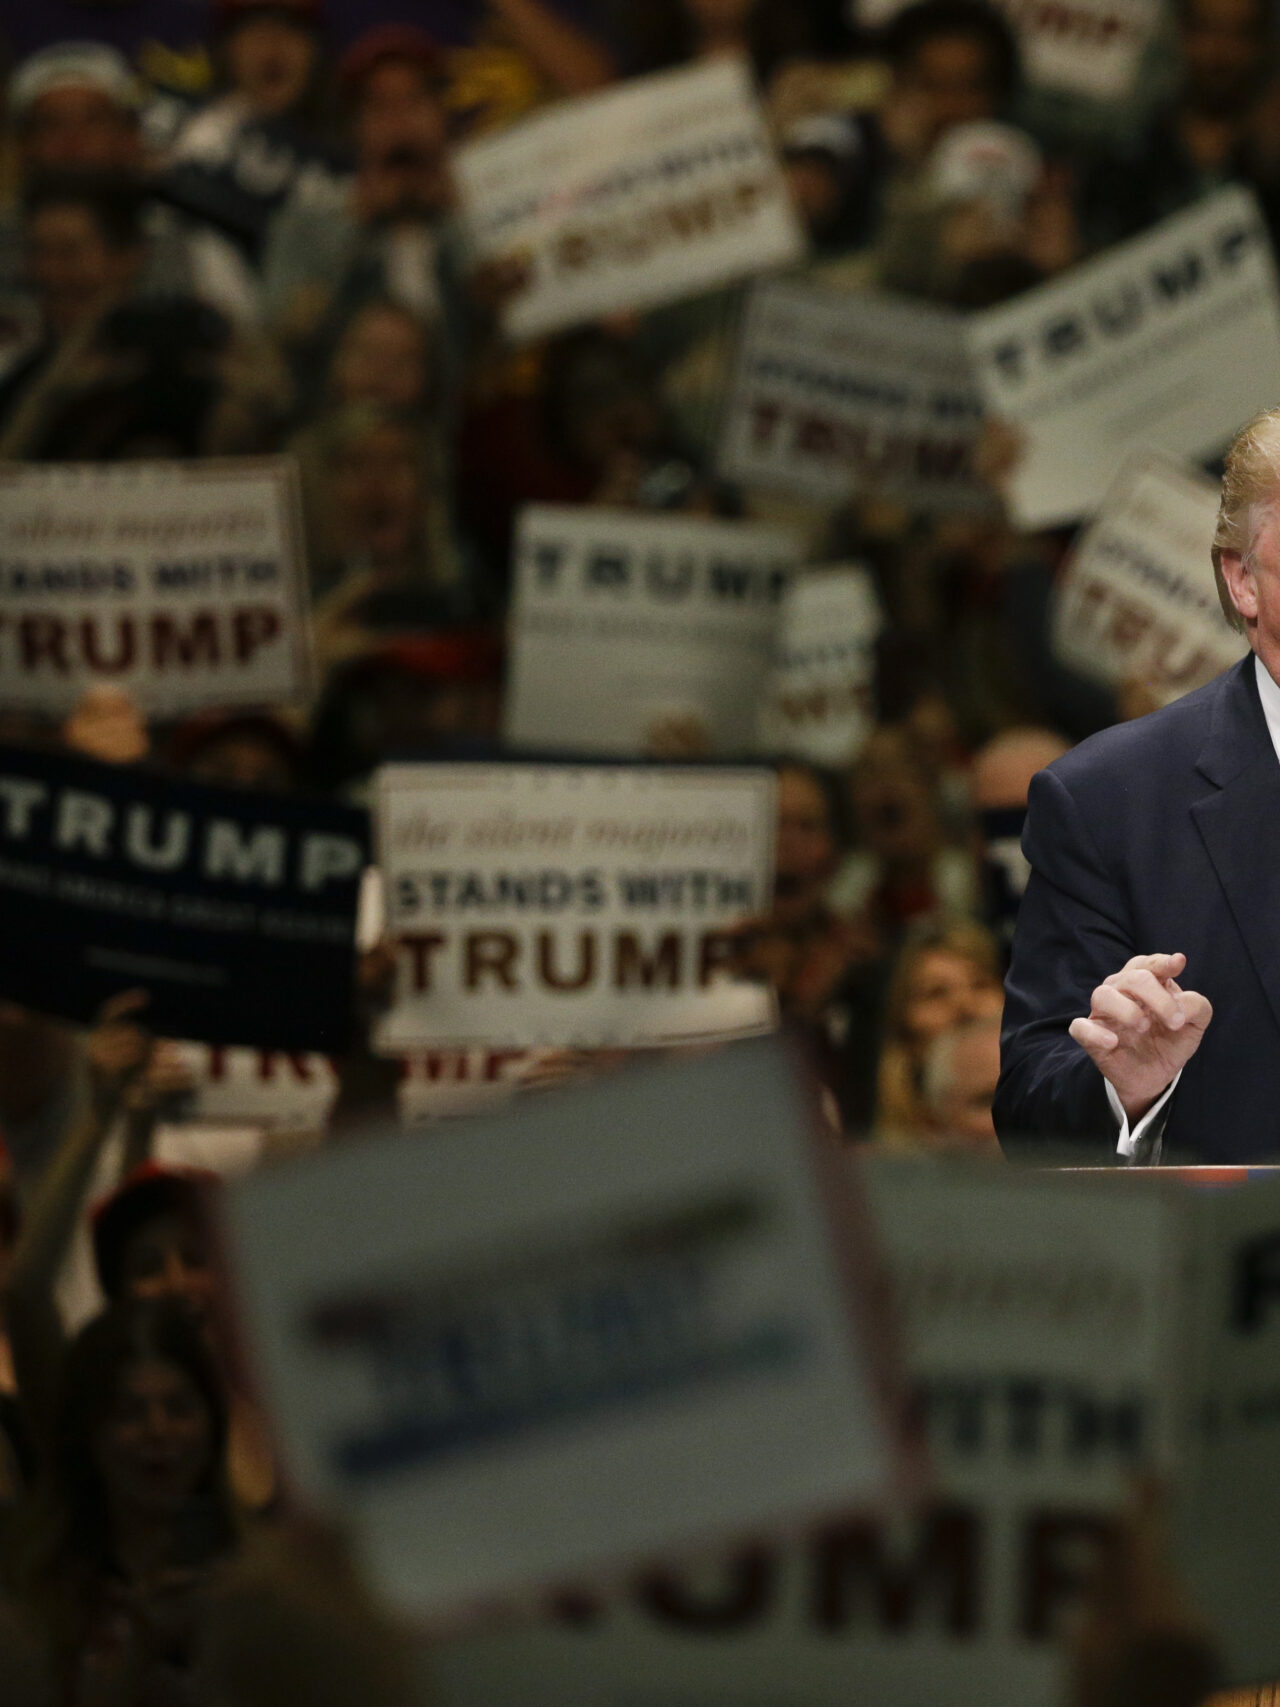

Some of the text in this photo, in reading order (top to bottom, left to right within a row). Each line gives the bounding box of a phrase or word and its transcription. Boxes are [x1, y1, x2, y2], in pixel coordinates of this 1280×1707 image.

[992, 224, 1254, 380] TRUMP
[748, 400, 976, 485] TRUM
[0, 606, 282, 675] RUMP
[0, 776, 363, 892] TRUMP
[397, 868, 607, 912] STANDS
[616, 866, 754, 908] WITH
